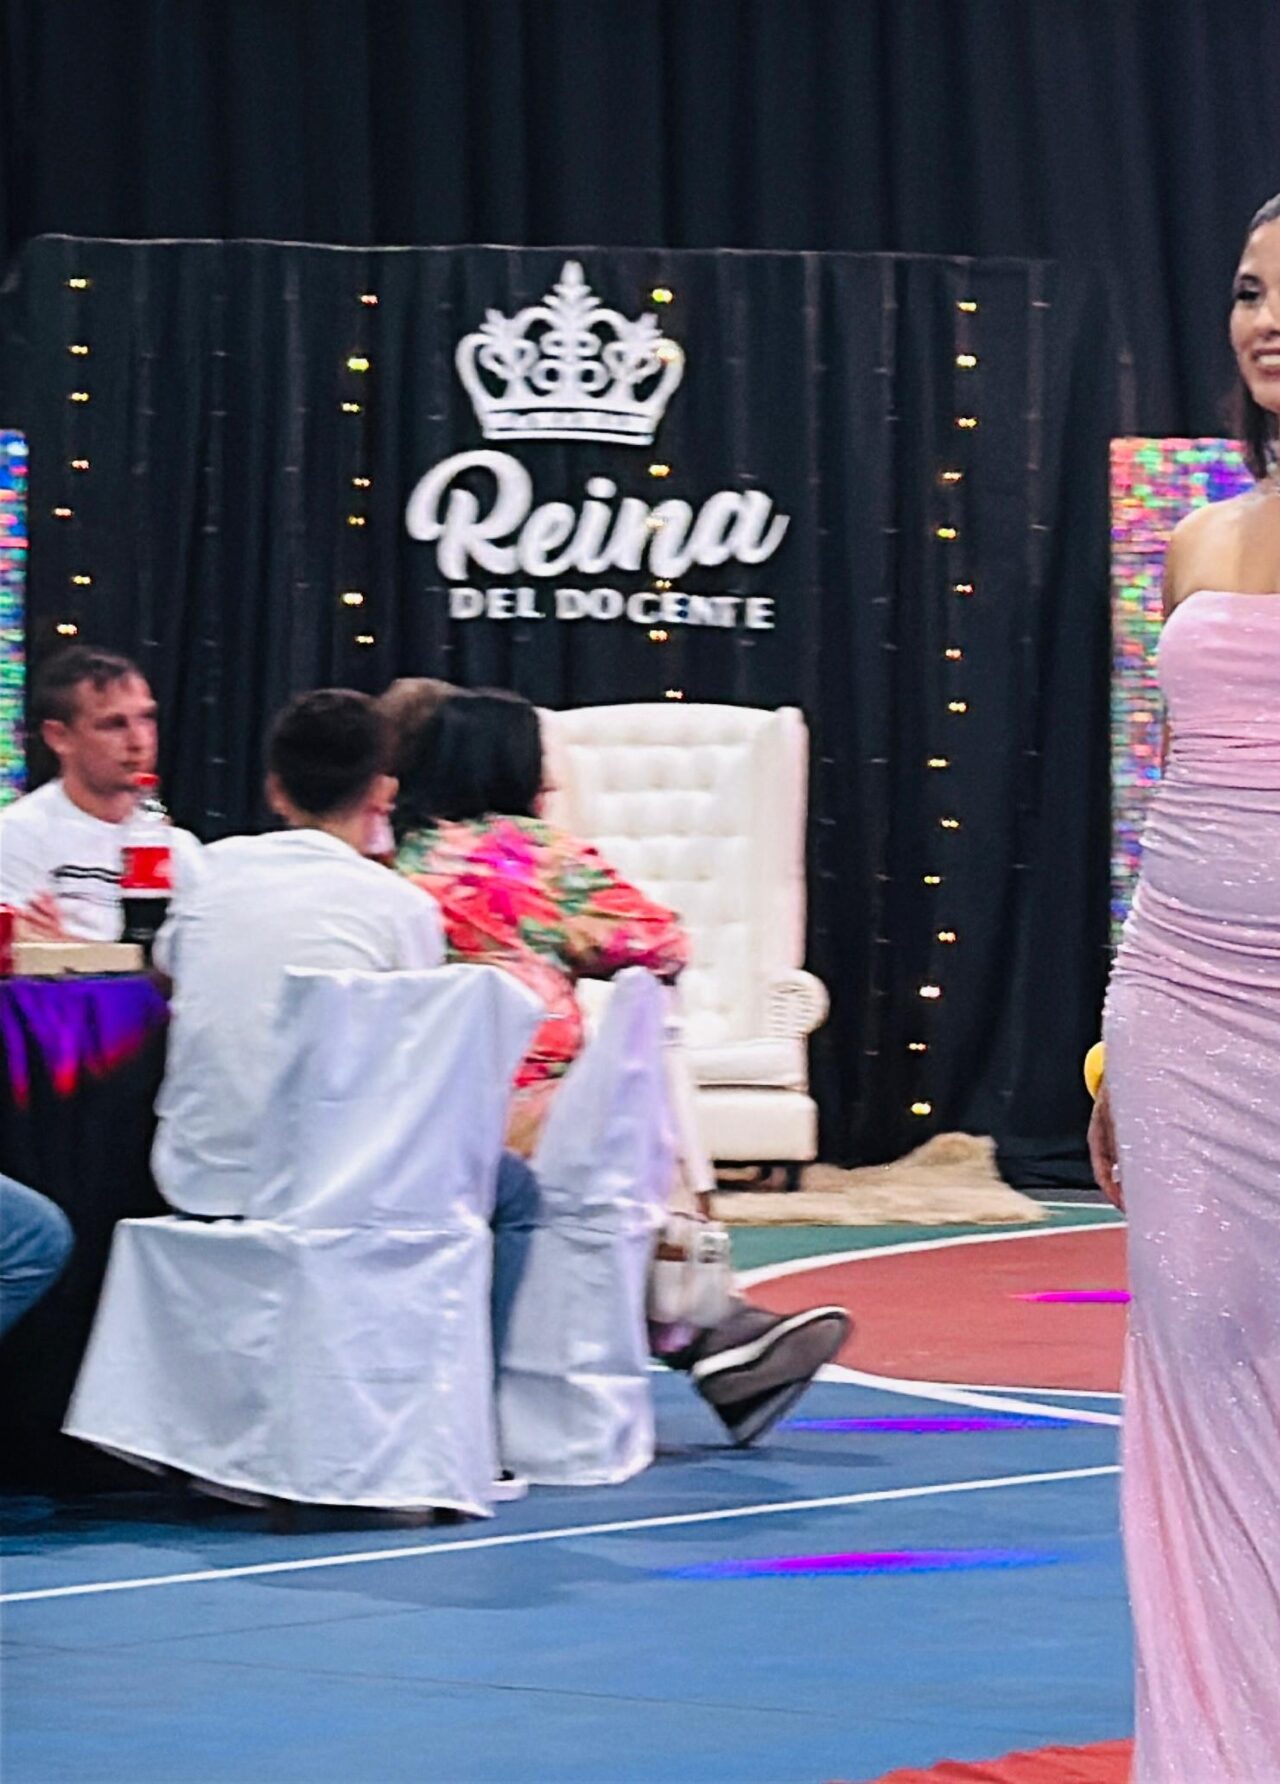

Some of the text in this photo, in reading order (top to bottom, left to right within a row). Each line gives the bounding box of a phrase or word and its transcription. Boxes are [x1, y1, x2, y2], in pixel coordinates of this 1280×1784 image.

[406, 449, 790, 580] Reina
[449, 587, 775, 629] DEL DOCENTE
